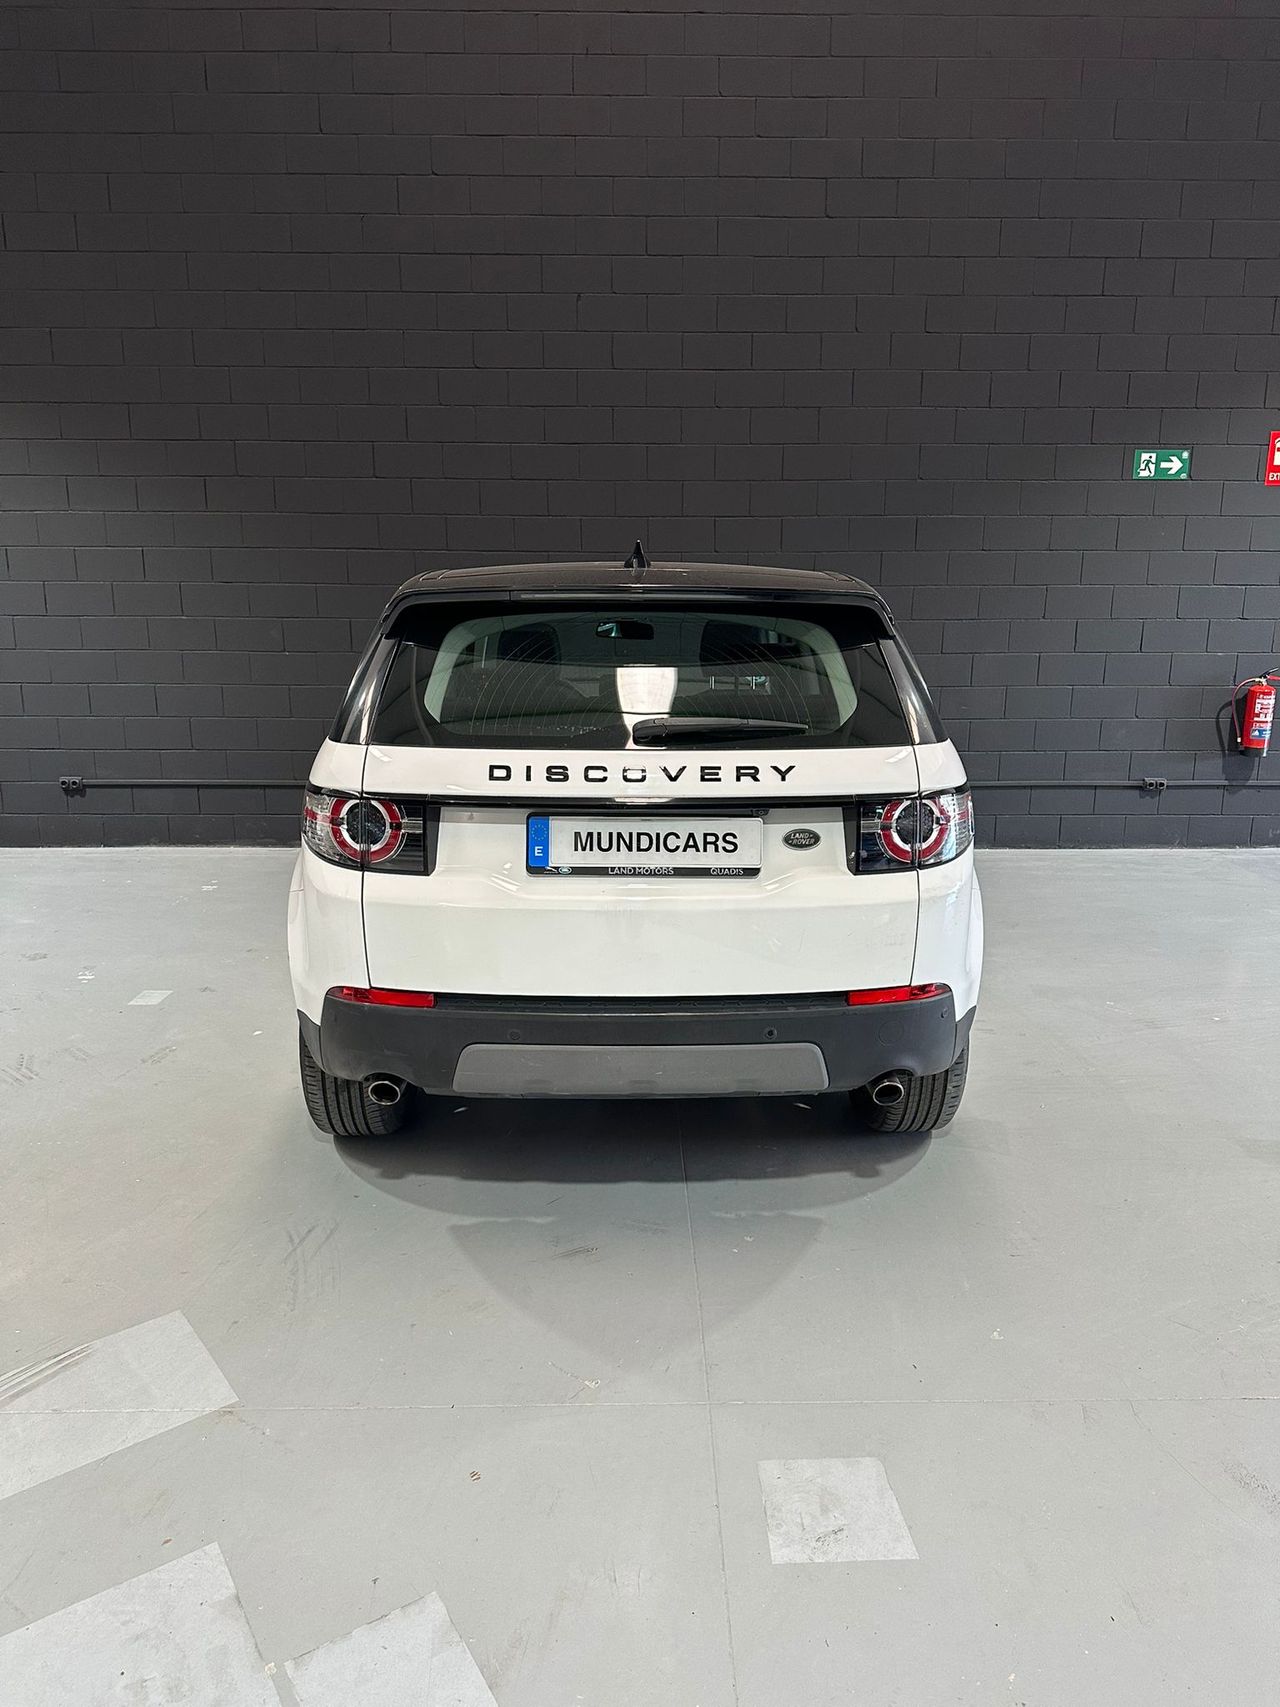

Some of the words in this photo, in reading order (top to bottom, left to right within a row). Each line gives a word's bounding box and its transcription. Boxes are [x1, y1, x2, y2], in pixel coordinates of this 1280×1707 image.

[488, 764, 796, 782] DISCOVERY
[573, 830, 739, 853] MUNDICARS
[534, 846, 544, 857] E
[608, 867, 634, 876] LAND
[635, 867, 674, 876] MOTORS
[710, 867, 744, 876] QUADIS
